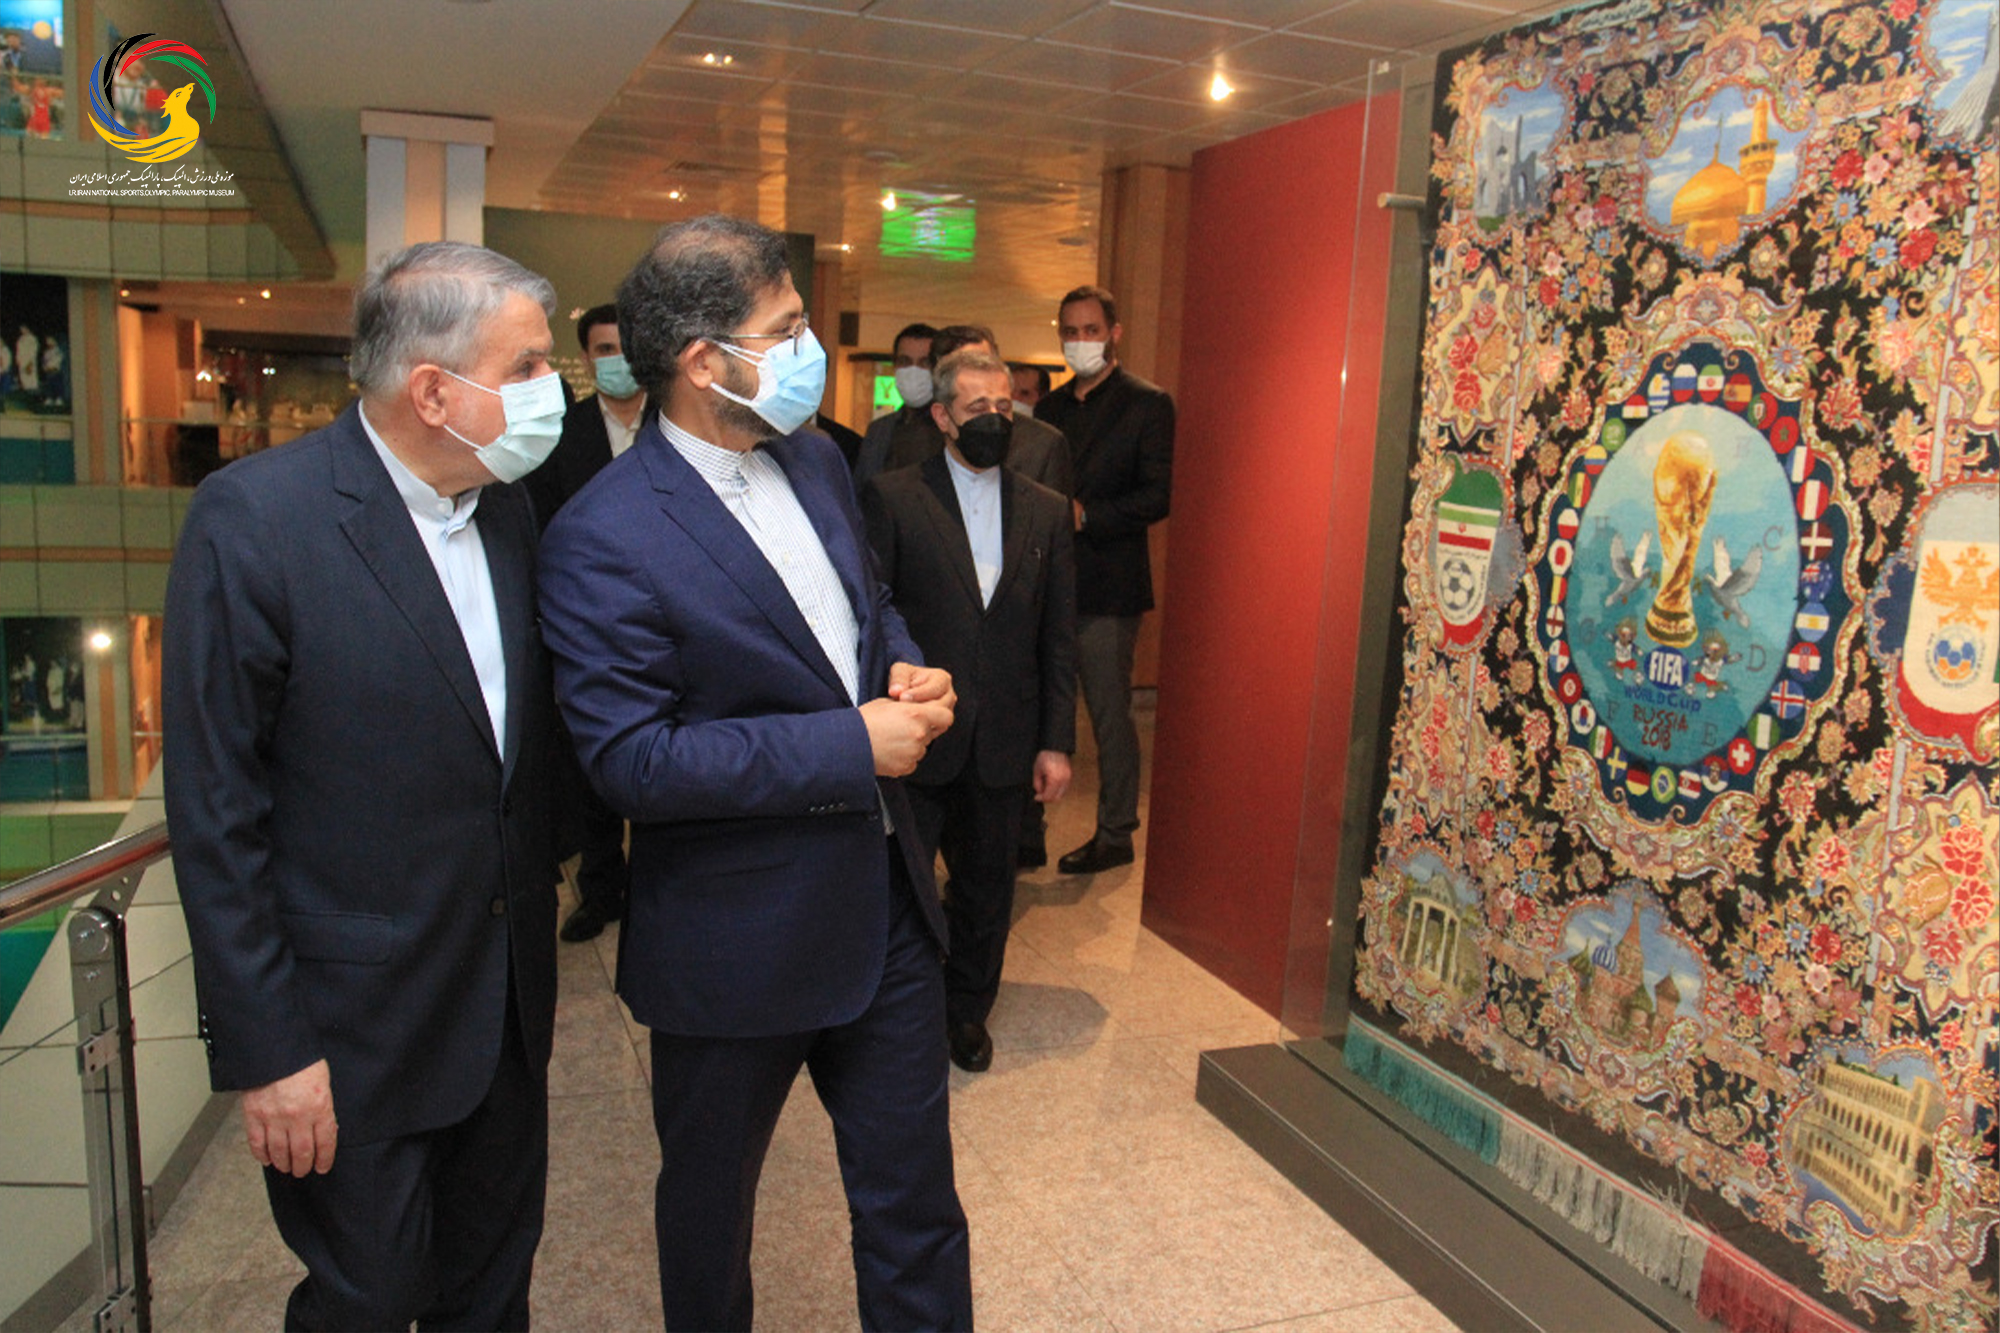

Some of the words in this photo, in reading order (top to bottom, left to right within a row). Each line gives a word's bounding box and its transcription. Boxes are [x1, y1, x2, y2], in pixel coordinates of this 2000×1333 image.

[1762, 525, 1784, 551] C
[1649, 650, 1684, 687] FIFA
[1747, 643, 1767, 672] D
[1624, 685, 1666, 704] WORLD
[1633, 703, 1689, 733] RUSSIA
[1641, 725, 1672, 752] 2018
[1702, 722, 1719, 748] E
